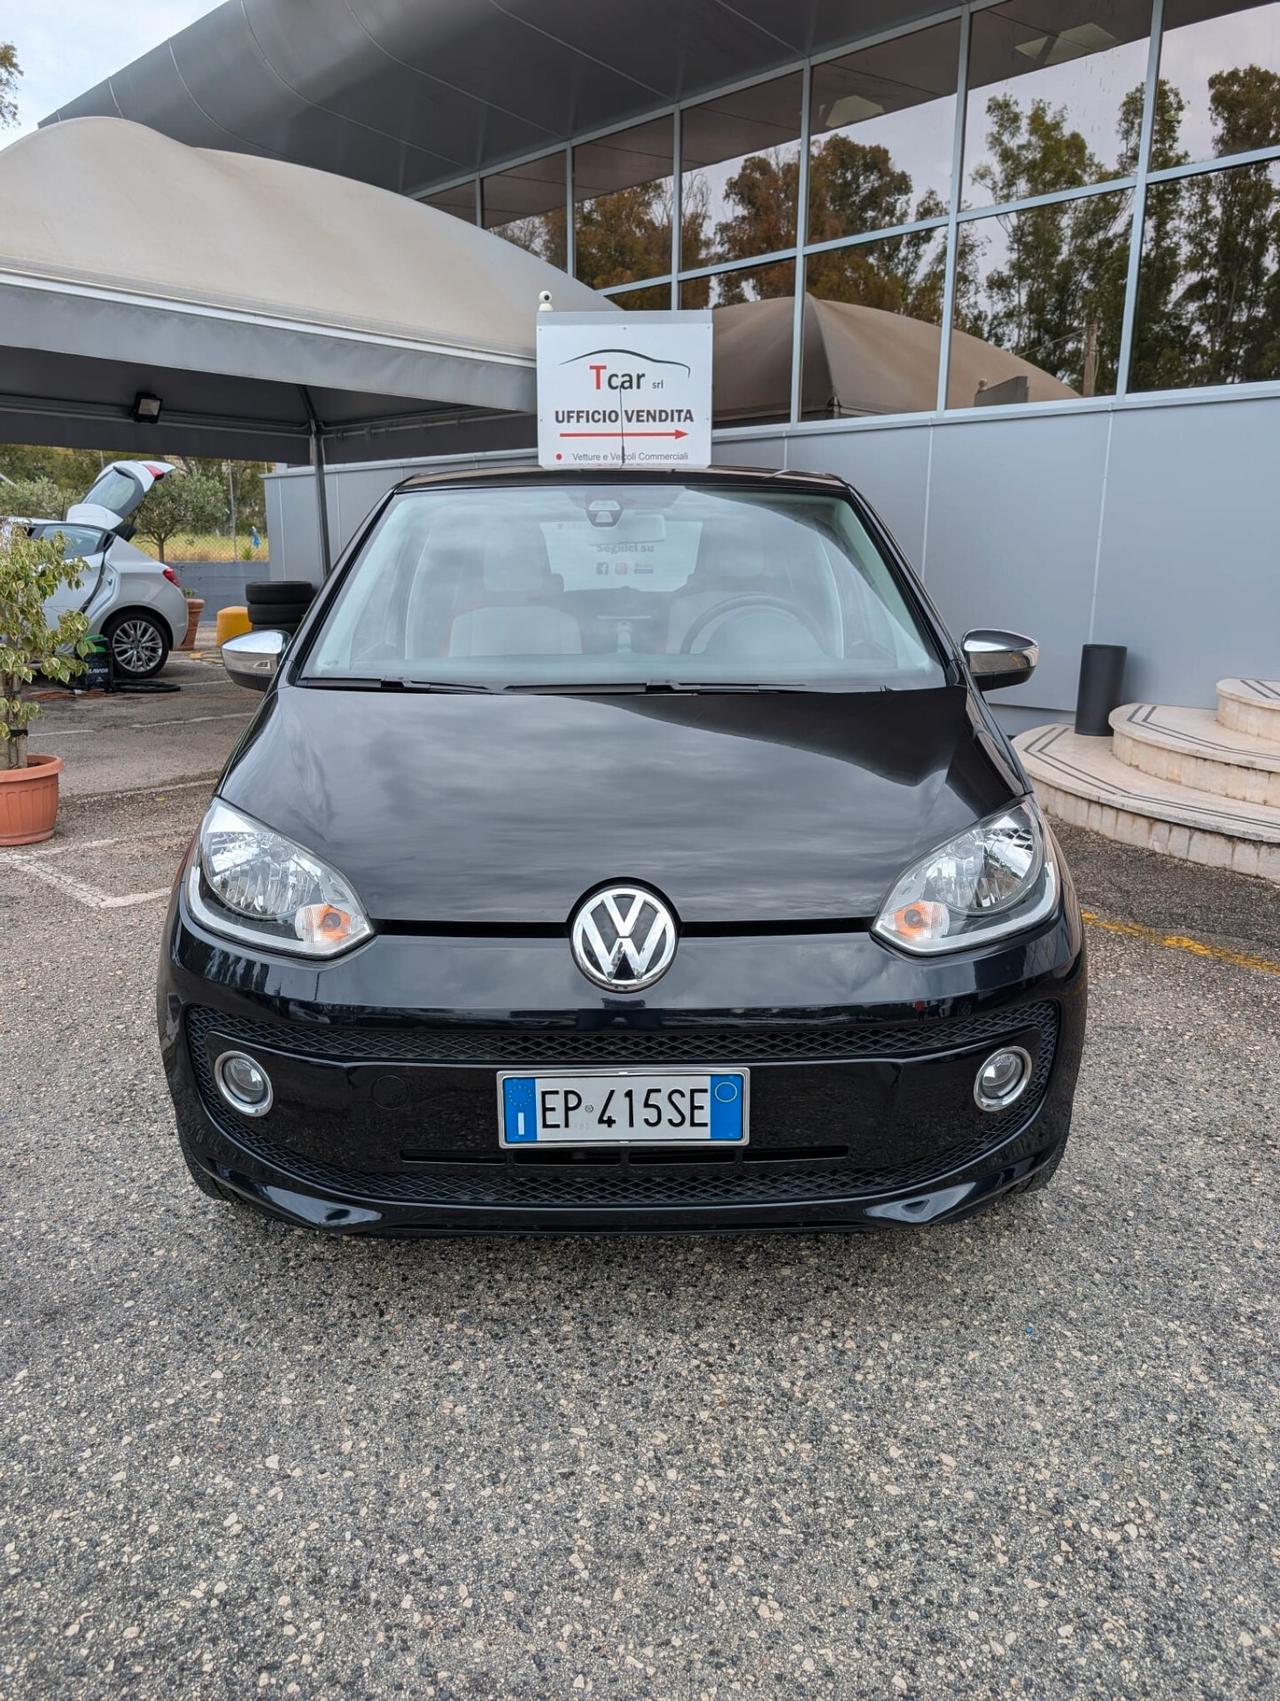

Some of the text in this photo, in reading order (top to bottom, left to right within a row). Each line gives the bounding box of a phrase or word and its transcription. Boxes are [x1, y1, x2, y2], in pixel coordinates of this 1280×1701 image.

[589, 365, 664, 390] Tcar srl
[554, 409, 694, 424] UFFICIO VENDITA
[572, 453, 600, 461] Vetture
[610, 452, 637, 461] Vecoli
[638, 451, 689, 461] Commerciali
[541, 1088, 709, 1129] EP 415SE
